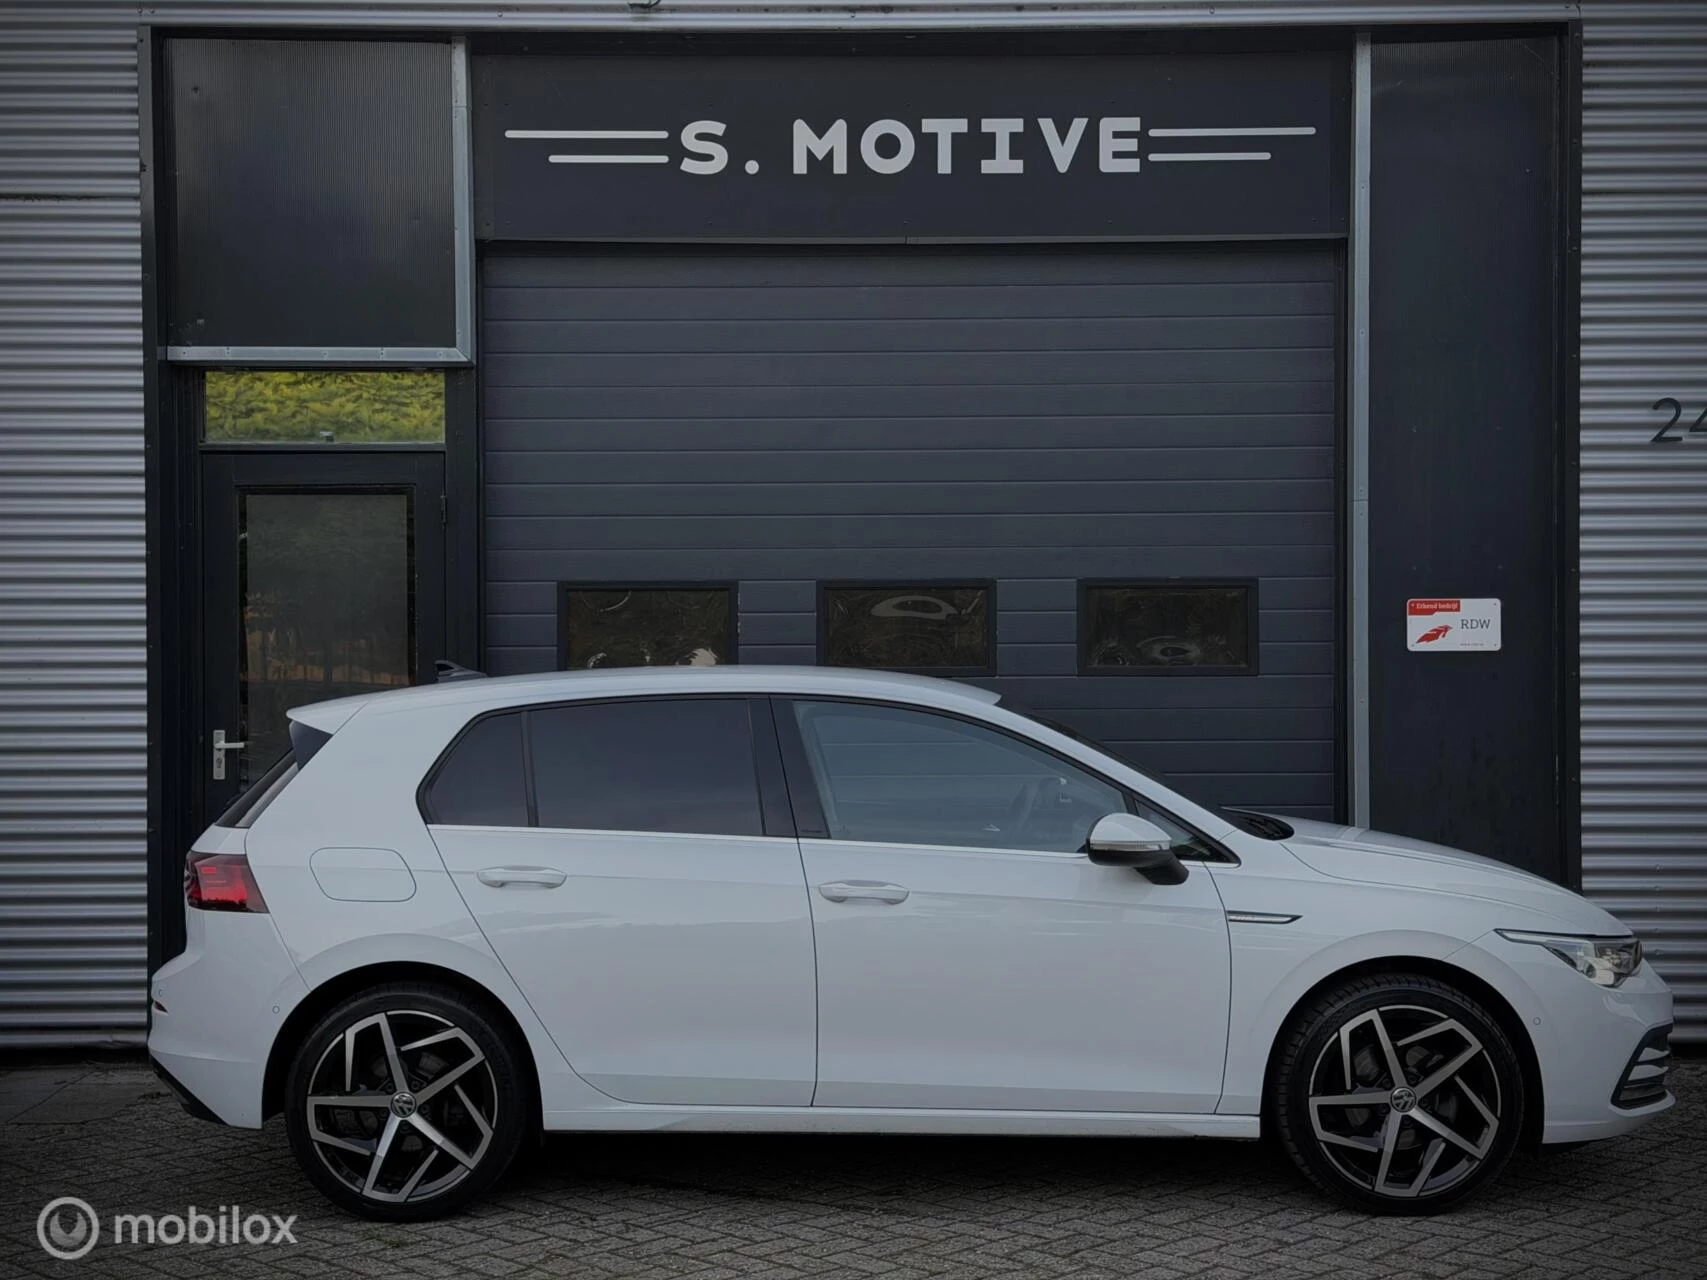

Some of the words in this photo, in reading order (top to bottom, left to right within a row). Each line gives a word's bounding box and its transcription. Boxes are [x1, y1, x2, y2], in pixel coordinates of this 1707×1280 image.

[679, 119, 760, 175] S.
[792, 117, 1141, 175] MOTIVE
[1460, 618, 1490, 630] RDW
